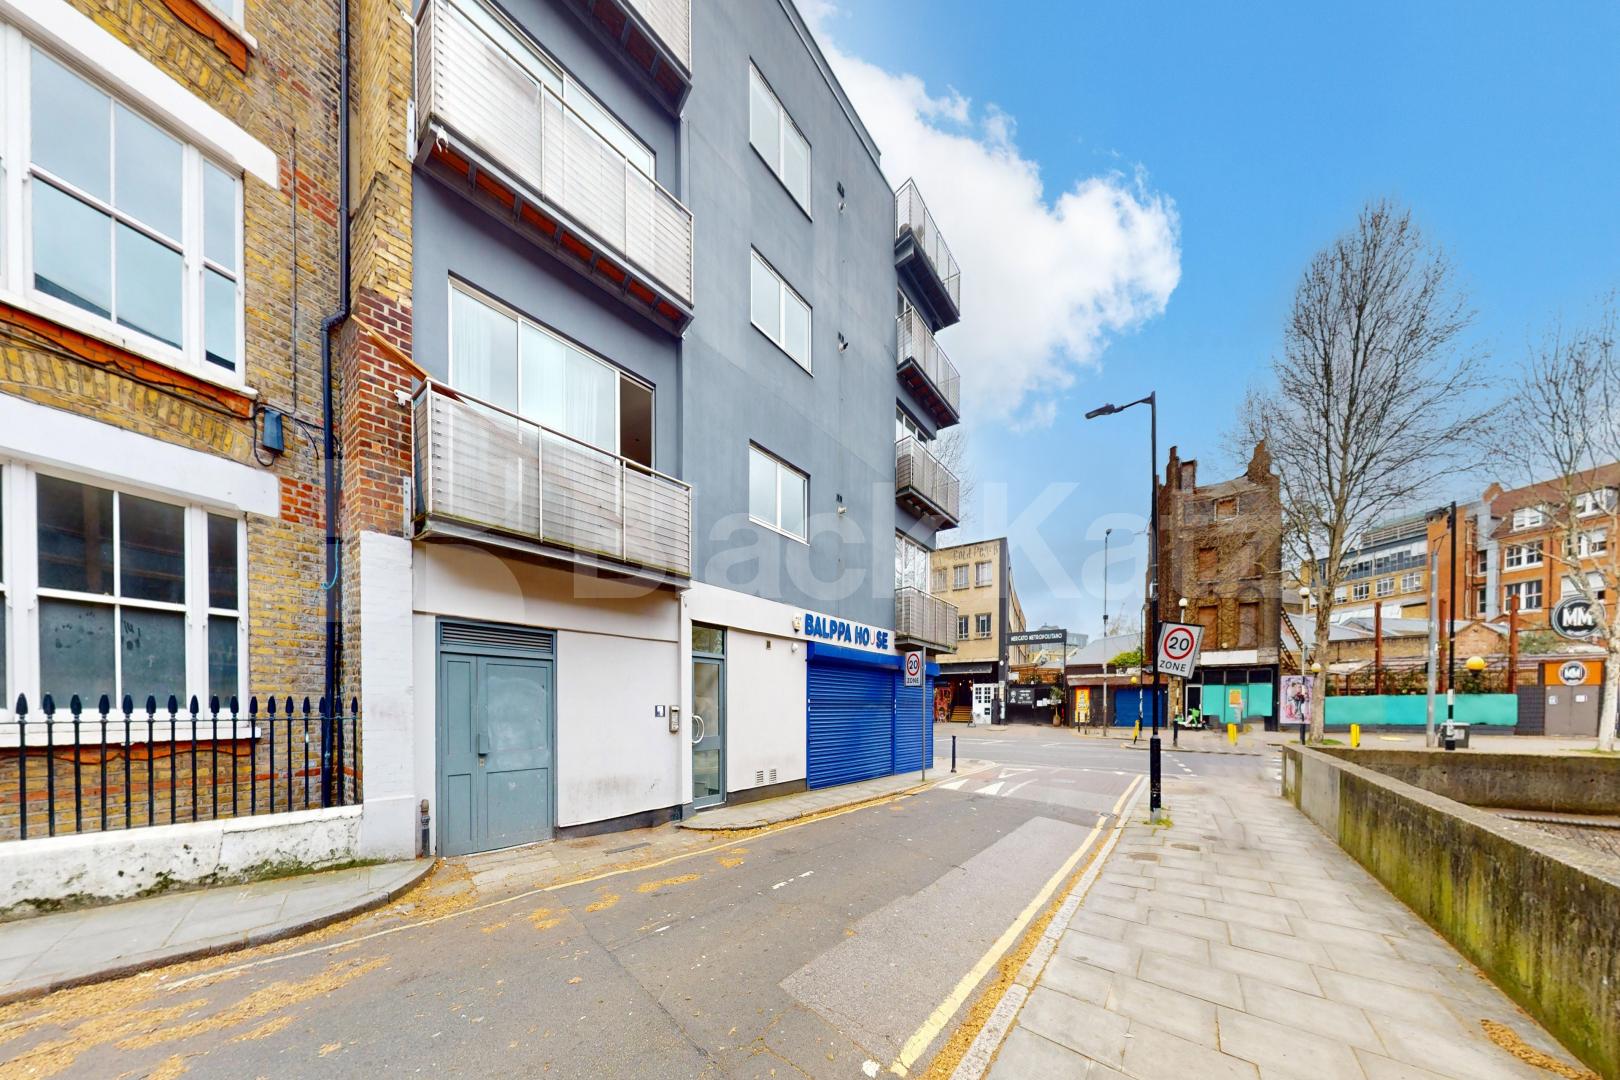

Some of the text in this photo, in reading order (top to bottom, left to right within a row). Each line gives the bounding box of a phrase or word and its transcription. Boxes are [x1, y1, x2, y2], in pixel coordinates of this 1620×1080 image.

[805, 613, 852, 643] BALPPA
[1029, 633, 1063, 641] METROPOLITANO
[1168, 636, 1190, 651] 20
[909, 659, 918, 670] 20
[1159, 660, 1186, 672] ZONE
